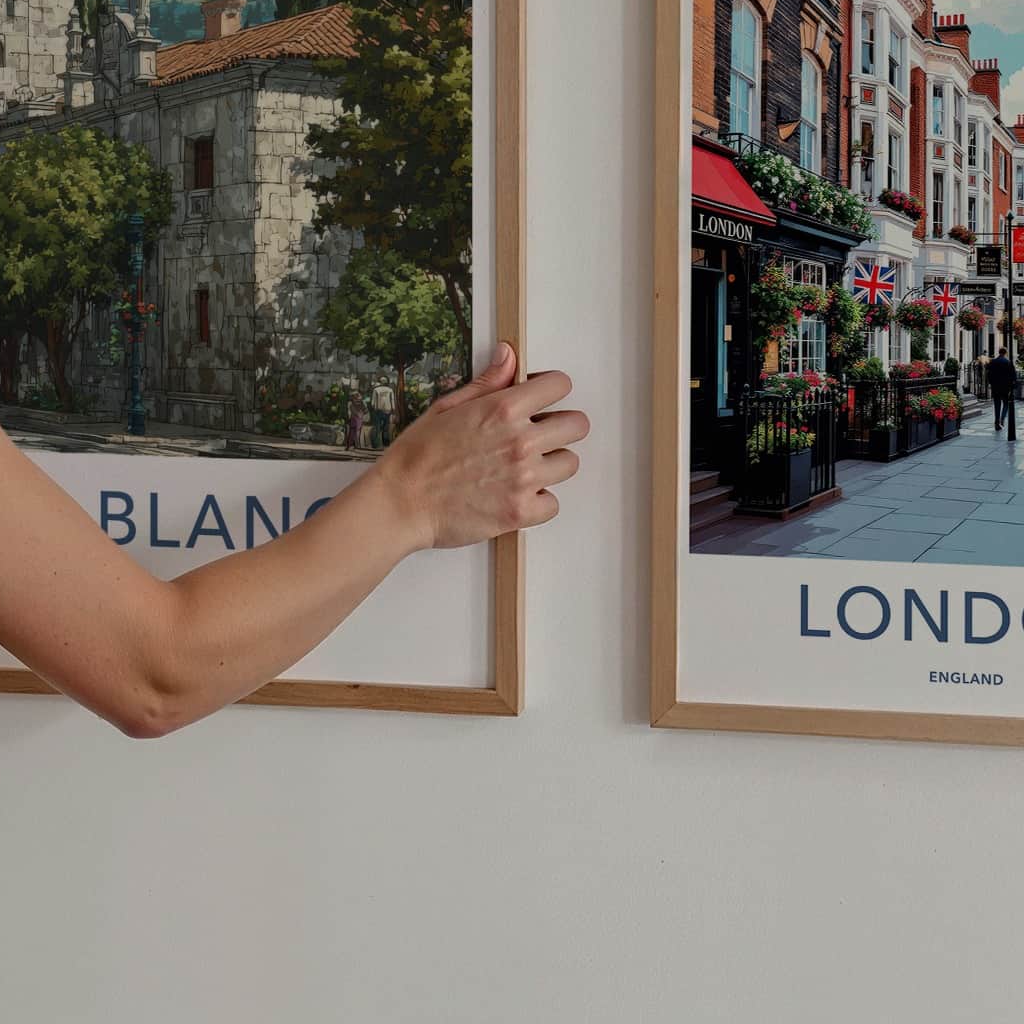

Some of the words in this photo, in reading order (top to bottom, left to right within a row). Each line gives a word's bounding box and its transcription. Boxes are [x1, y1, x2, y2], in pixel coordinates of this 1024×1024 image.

[699, 213, 753, 242] LONDON
[99, 490, 334, 550] BLAN
[800, 583, 1024, 645] LOND
[929, 671, 1004, 686] ENGLAND
